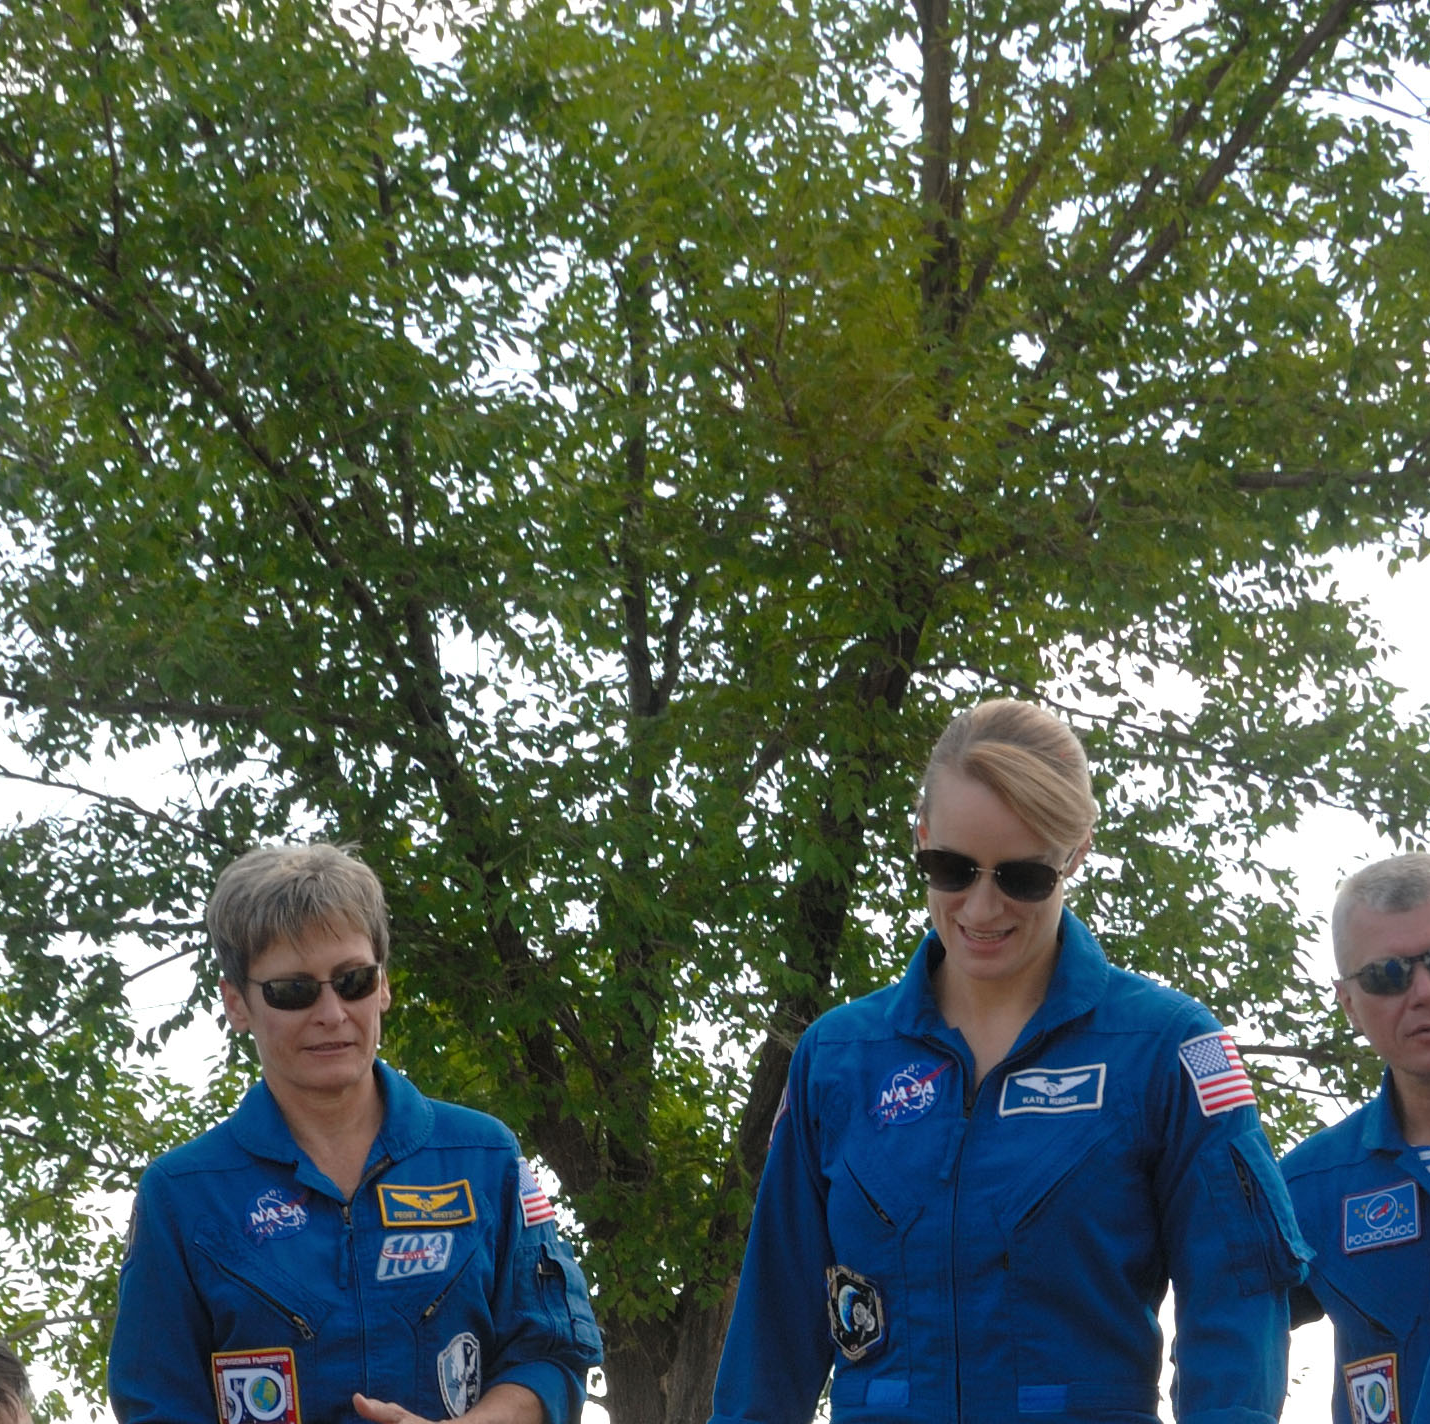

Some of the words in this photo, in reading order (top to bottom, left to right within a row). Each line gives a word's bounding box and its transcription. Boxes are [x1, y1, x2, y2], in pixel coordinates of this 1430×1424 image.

[881, 1080, 935, 1107] NASA
[250, 1204, 307, 1226] NASA
[1348, 1222, 1415, 1247] РОСКОСМОС
